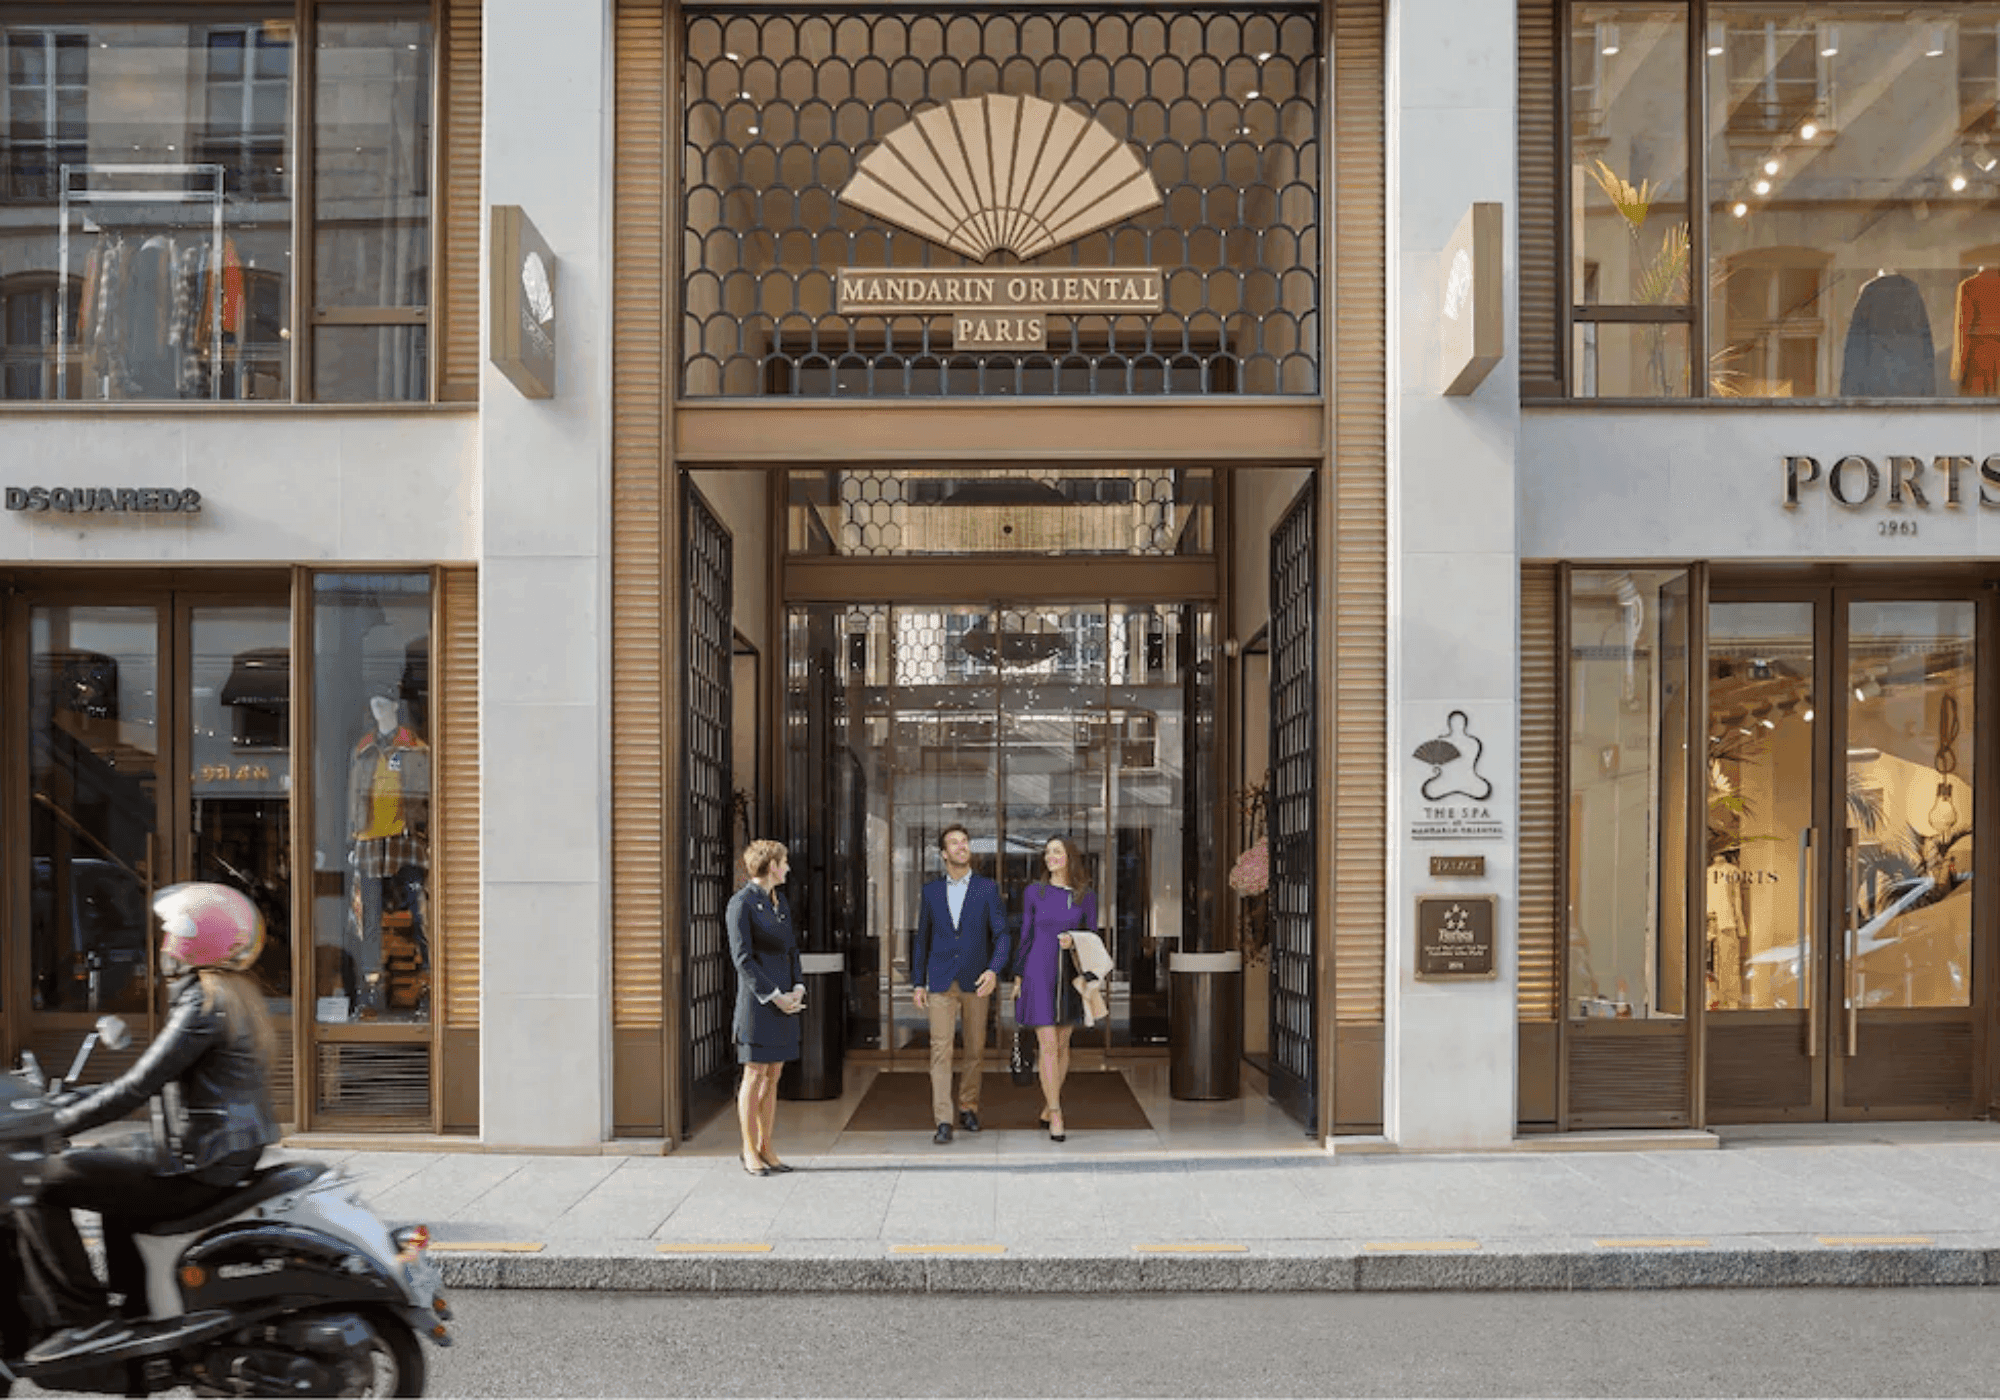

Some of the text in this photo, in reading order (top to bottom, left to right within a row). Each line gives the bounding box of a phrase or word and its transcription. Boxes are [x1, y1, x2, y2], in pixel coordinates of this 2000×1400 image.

[841, 278, 1159, 301] MANDARIN ORIENTAL
[958, 319, 1042, 342] PARIS
[1782, 455, 2000, 510] PORTS
[5, 486, 202, 512] DSQUARED2
[1877, 521, 1919, 536] 1961
[1423, 807, 1491, 819] THE SPA
